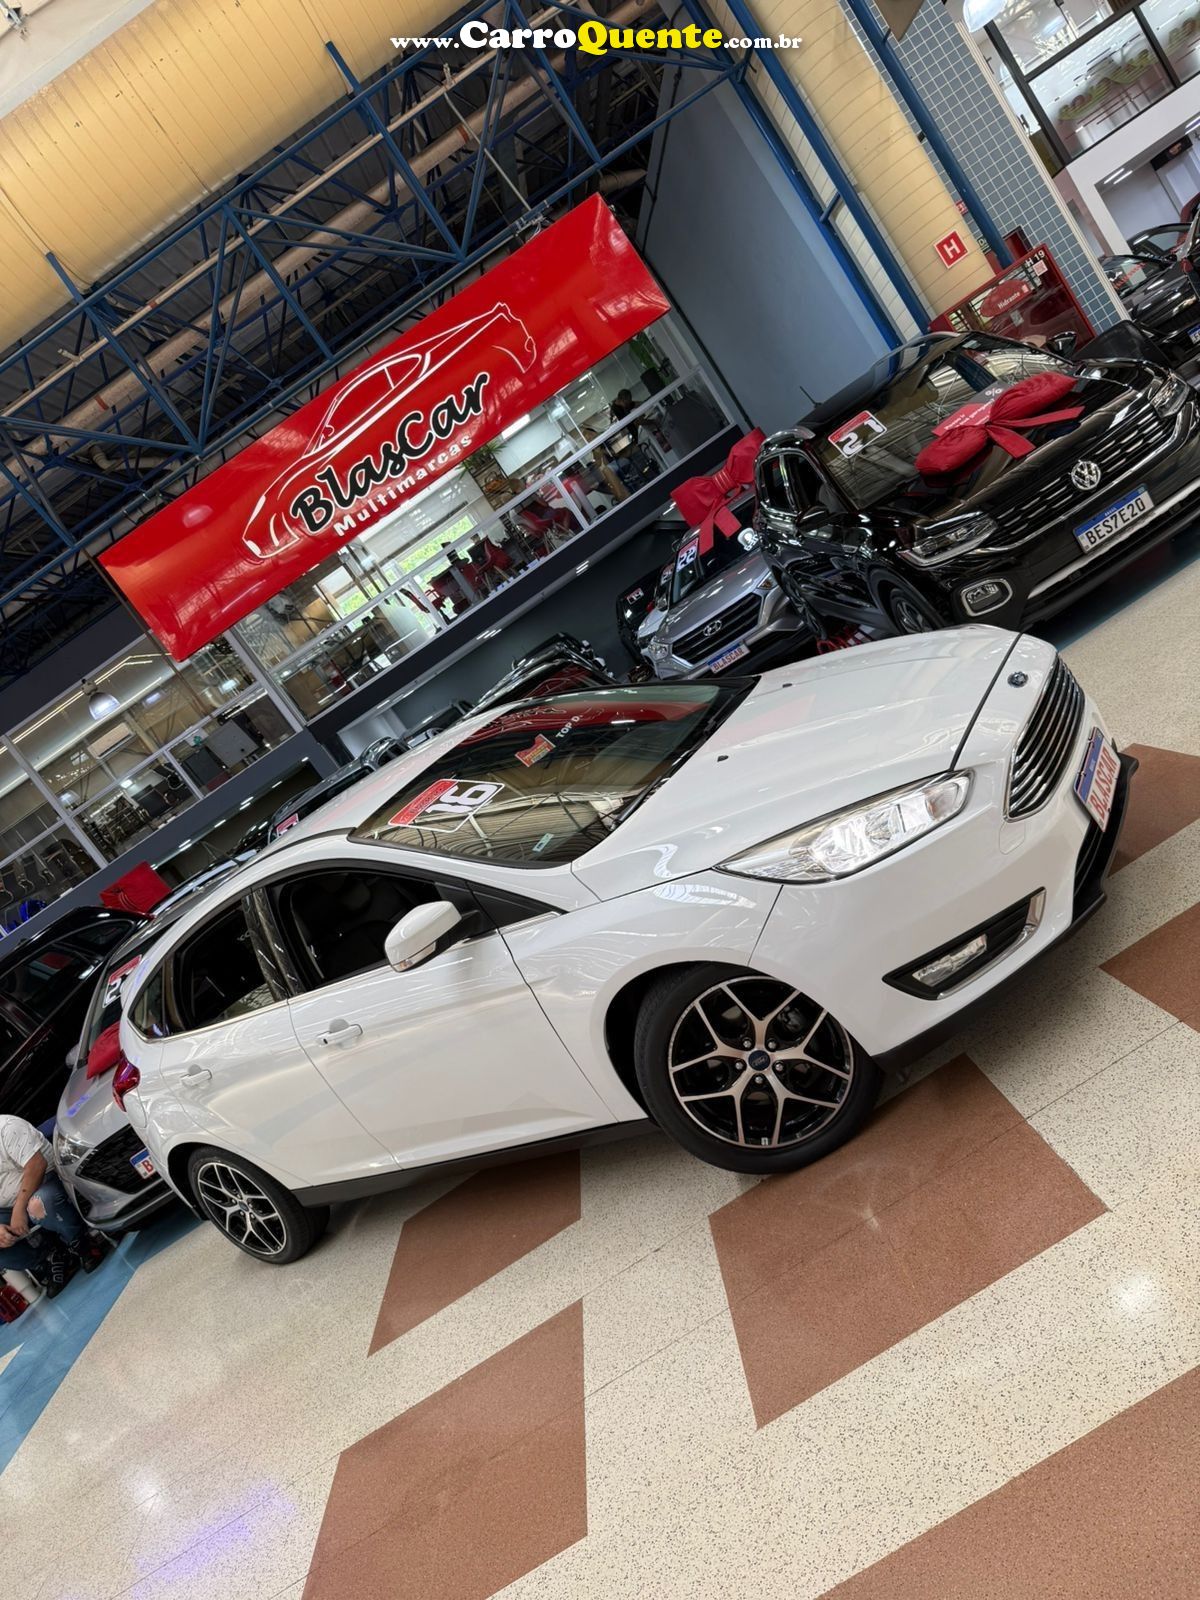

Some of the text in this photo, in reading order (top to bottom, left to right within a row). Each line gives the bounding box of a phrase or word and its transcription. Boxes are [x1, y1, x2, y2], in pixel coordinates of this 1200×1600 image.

[943, 238, 961, 259] H
[1034, 249, 1046, 261] 19
[997, 291, 1020, 309] Hidrante
[290, 372, 490, 532] BlasCar
[333, 435, 472, 537] Multimarcas
[1085, 498, 1146, 544] BES7E20
[677, 546, 697, 571] 22
[713, 648, 744, 671] BLASCAR
[555, 722, 573, 738] TOP
[1090, 745, 1118, 820] BLASCAR
[425, 784, 498, 813] 16
